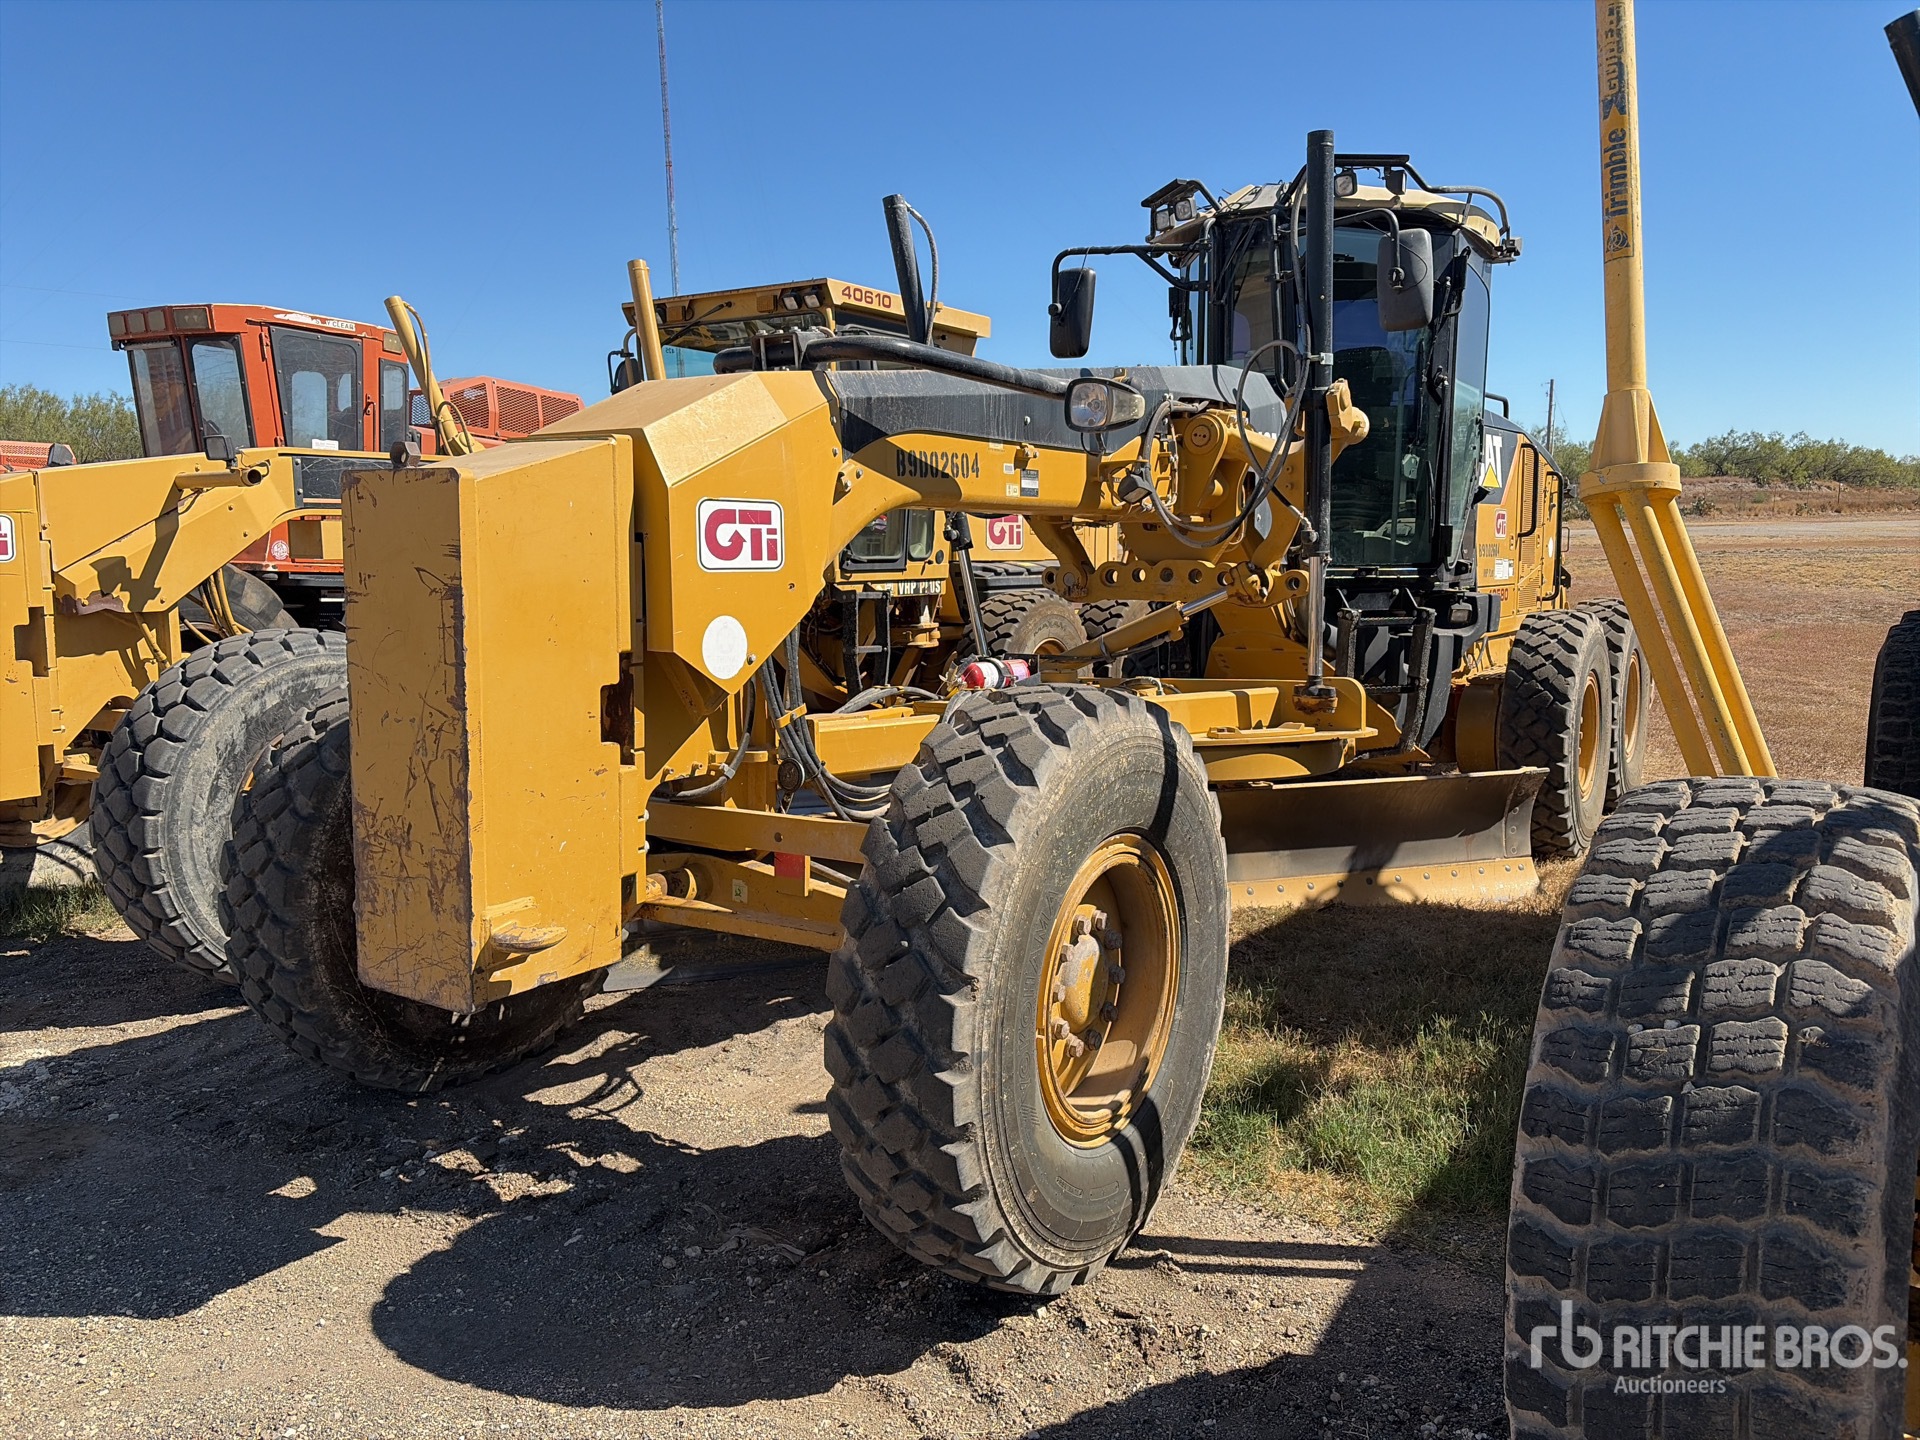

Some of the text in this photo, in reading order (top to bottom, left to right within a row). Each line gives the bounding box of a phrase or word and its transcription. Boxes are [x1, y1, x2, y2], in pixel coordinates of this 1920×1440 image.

[1605, 127, 1628, 224] Trimble
[841, 286, 892, 309] 40610
[896, 449, 980, 479] B9D02604
[898, 581, 917, 595] VHP
